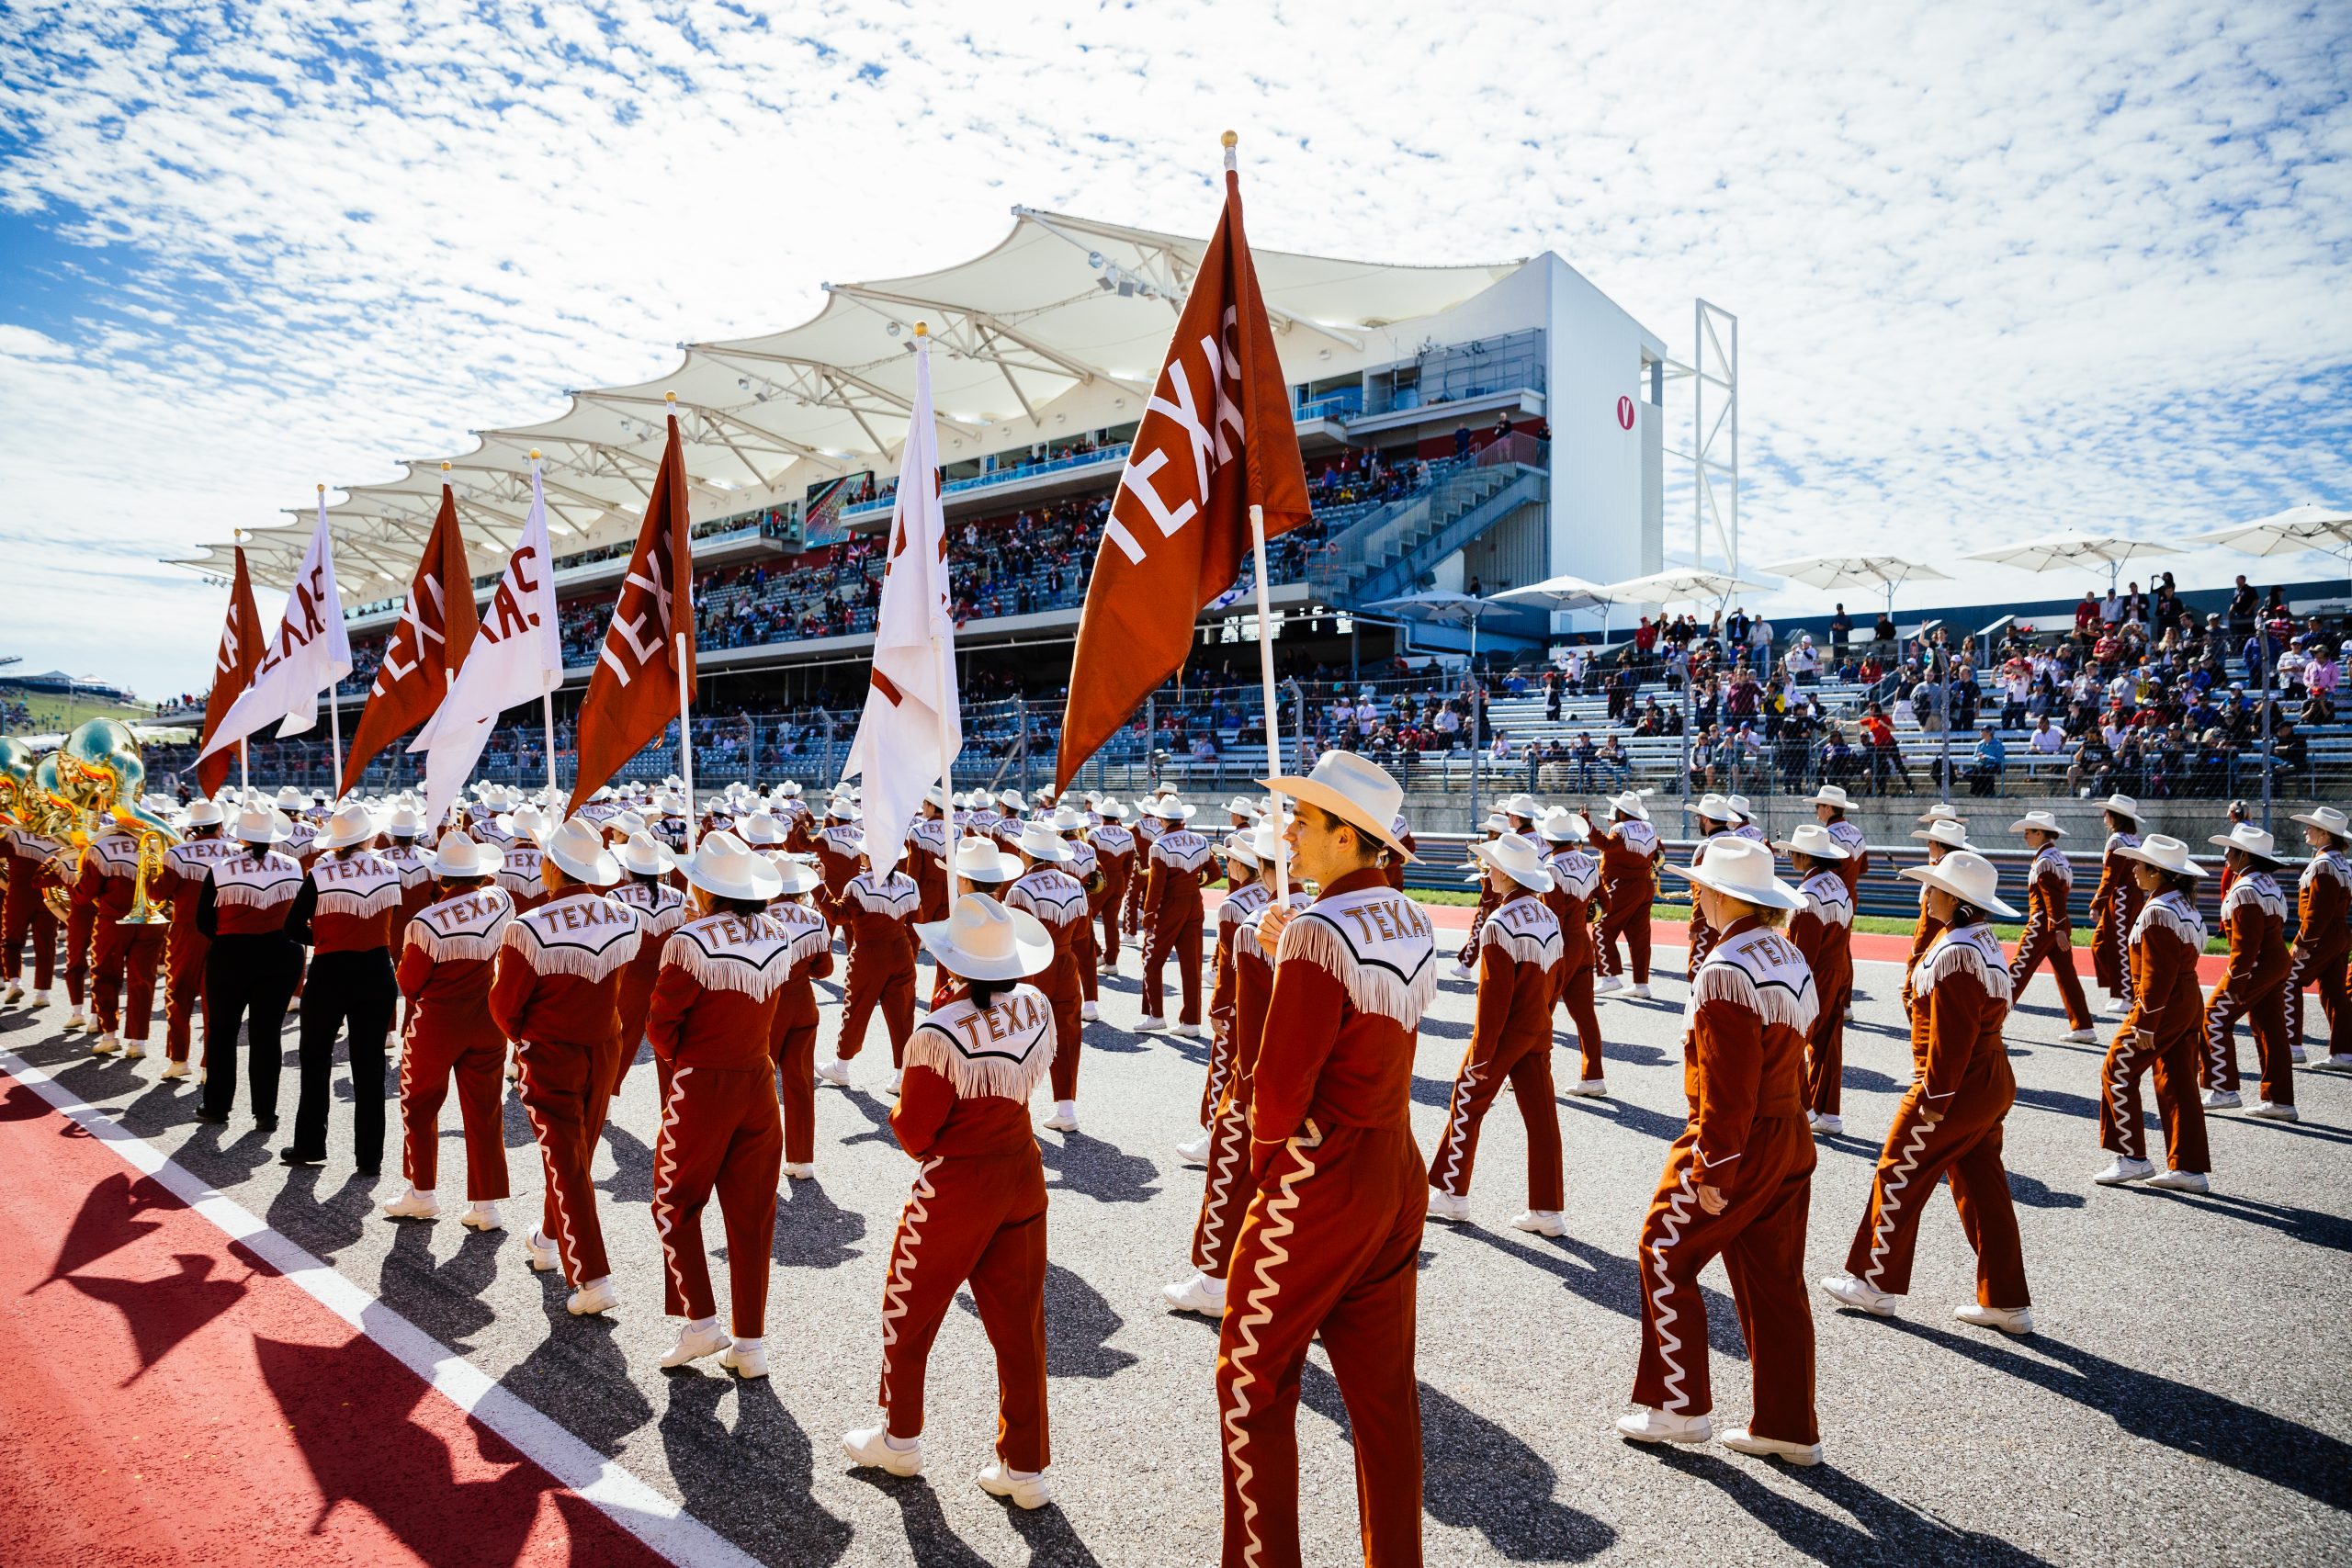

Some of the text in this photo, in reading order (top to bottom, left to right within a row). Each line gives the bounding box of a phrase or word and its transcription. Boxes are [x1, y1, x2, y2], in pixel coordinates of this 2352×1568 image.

[975, 813, 998, 822] TEXAS
[291, 825, 315, 838] XAS
[922, 823, 944, 834] TEX
[1004, 821, 1024, 829] TEX
[1102, 827, 1129, 837] TEXAS
[835, 829, 863, 839] TEXAS
[107, 841, 139, 855] TEX
[1070, 842, 1091, 855] XAS
[1163, 835, 1202, 849] TEXAS
[180, 843, 242, 858] TEXAS
[382, 848, 418, 861] TEX
[226, 855, 293, 875] TEXAS
[504, 852, 544, 868] TEX
[1557, 854, 1595, 872] TEXAS
[321, 859, 395, 882] TEXAS
[865, 875, 912, 890] TAS
[1030, 874, 1078, 892] TEXAS
[621, 886, 680, 903] TEAS
[539, 902, 631, 933] TEXAS
[696, 916, 786, 949] TEXAS
